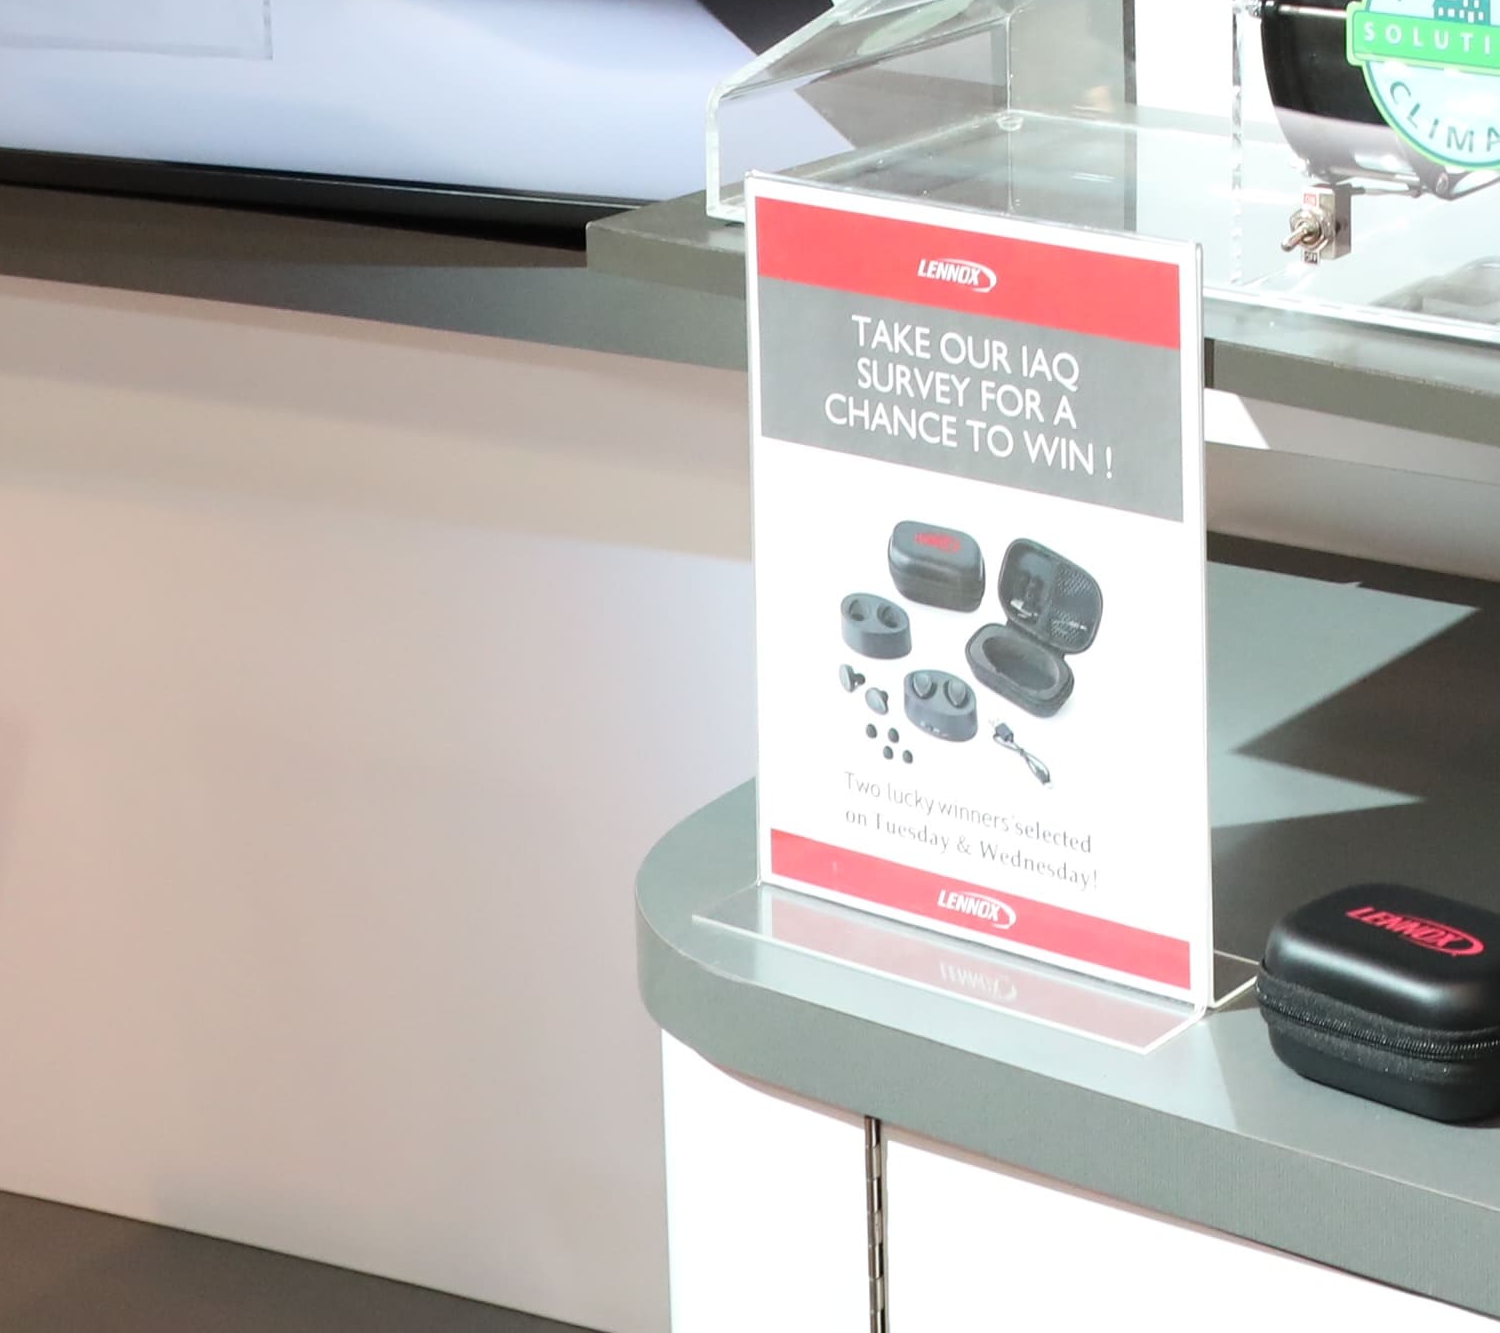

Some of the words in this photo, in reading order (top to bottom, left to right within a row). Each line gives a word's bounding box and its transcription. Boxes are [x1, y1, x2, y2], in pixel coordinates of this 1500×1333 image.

[917, 258, 982, 287] LENNOX
[852, 315, 930, 360] TAKE
[940, 332, 1012, 375] OUR
[1022, 348, 1080, 393] IAQ
[857, 356, 971, 403] SURVEY
[981, 381, 1045, 423] FOR
[1053, 395, 1077, 429] A
[824, 393, 957, 448] CHANCE
[966, 419, 1014, 458] TO
[1023, 435, 1095, 476] WIN
[844, 770, 881, 798] Two
[887, 782, 935, 816] lucky
[1015, 821, 1093, 854] selected
[845, 808, 868, 827] on
[875, 812, 951, 855] Tuesday
[956, 836, 972, 856] &
[979, 840, 1098, 891] Wednesday!
[938, 889, 1002, 922] LENNOX
[1345, 906, 1463, 950] LENNOX
